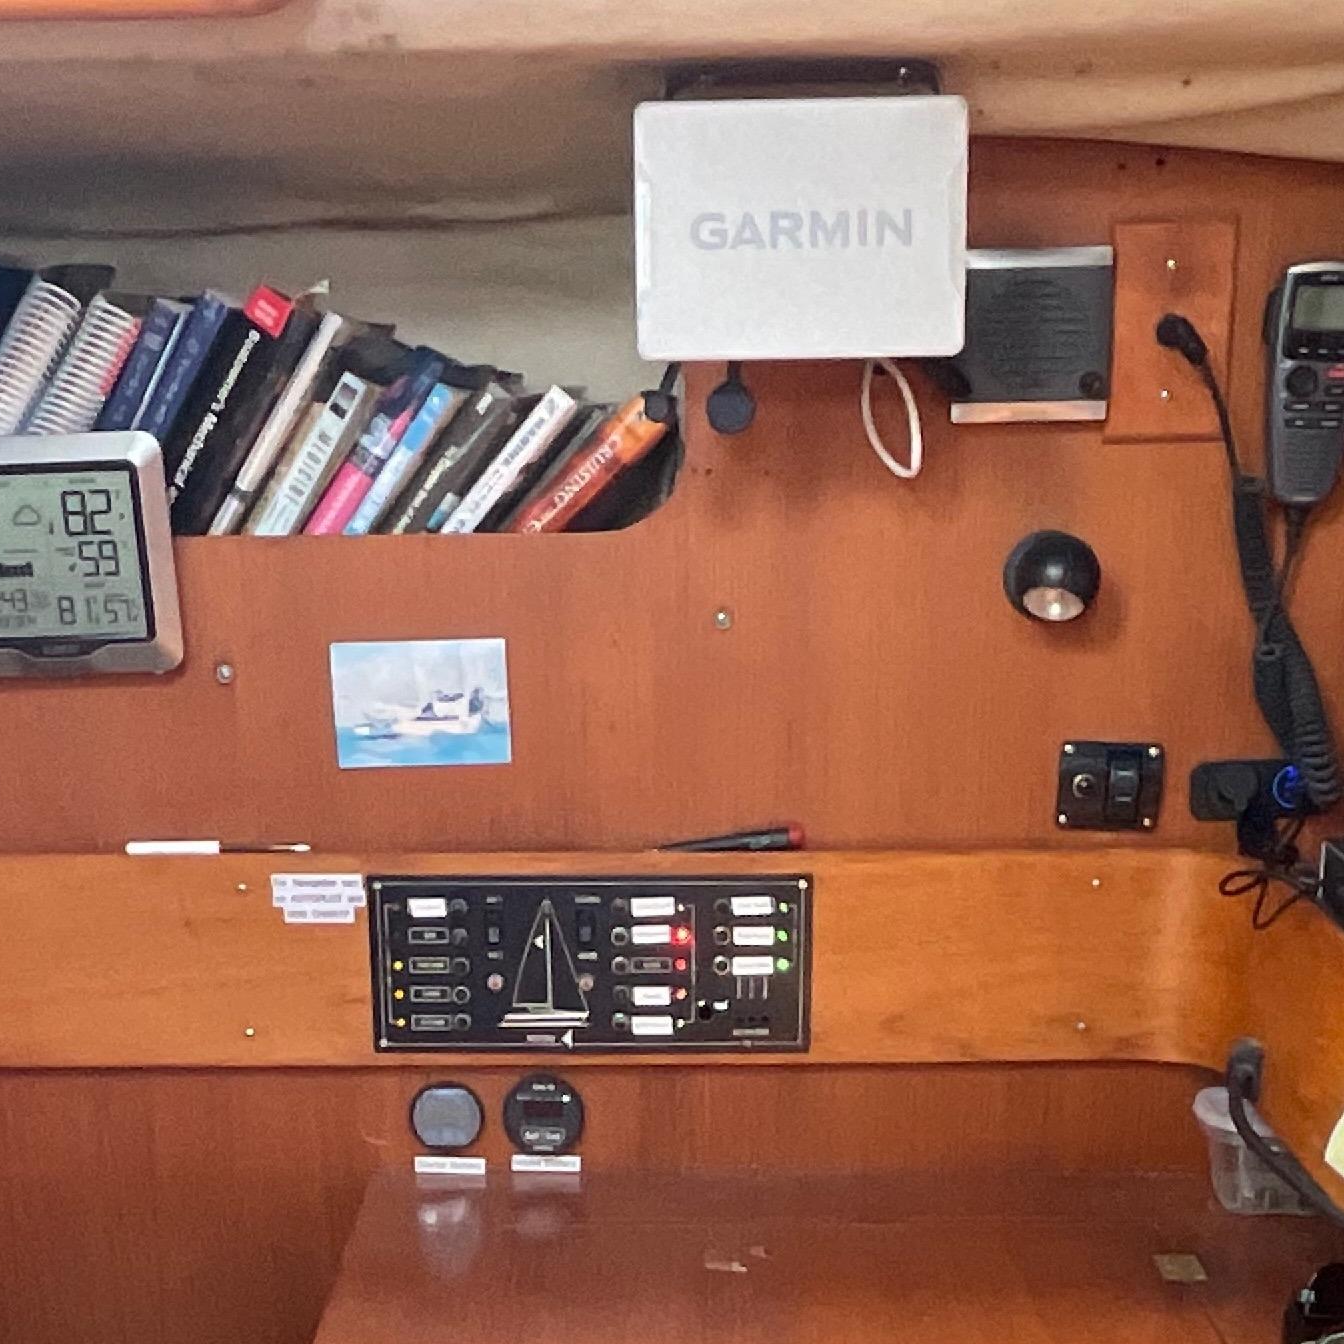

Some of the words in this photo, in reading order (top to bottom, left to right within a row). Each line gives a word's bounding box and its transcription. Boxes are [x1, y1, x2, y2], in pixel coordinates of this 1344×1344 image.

[689, 208, 913, 251] GARMIN
[61, 488, 112, 537] 82
[78, 539, 120, 577] 59
